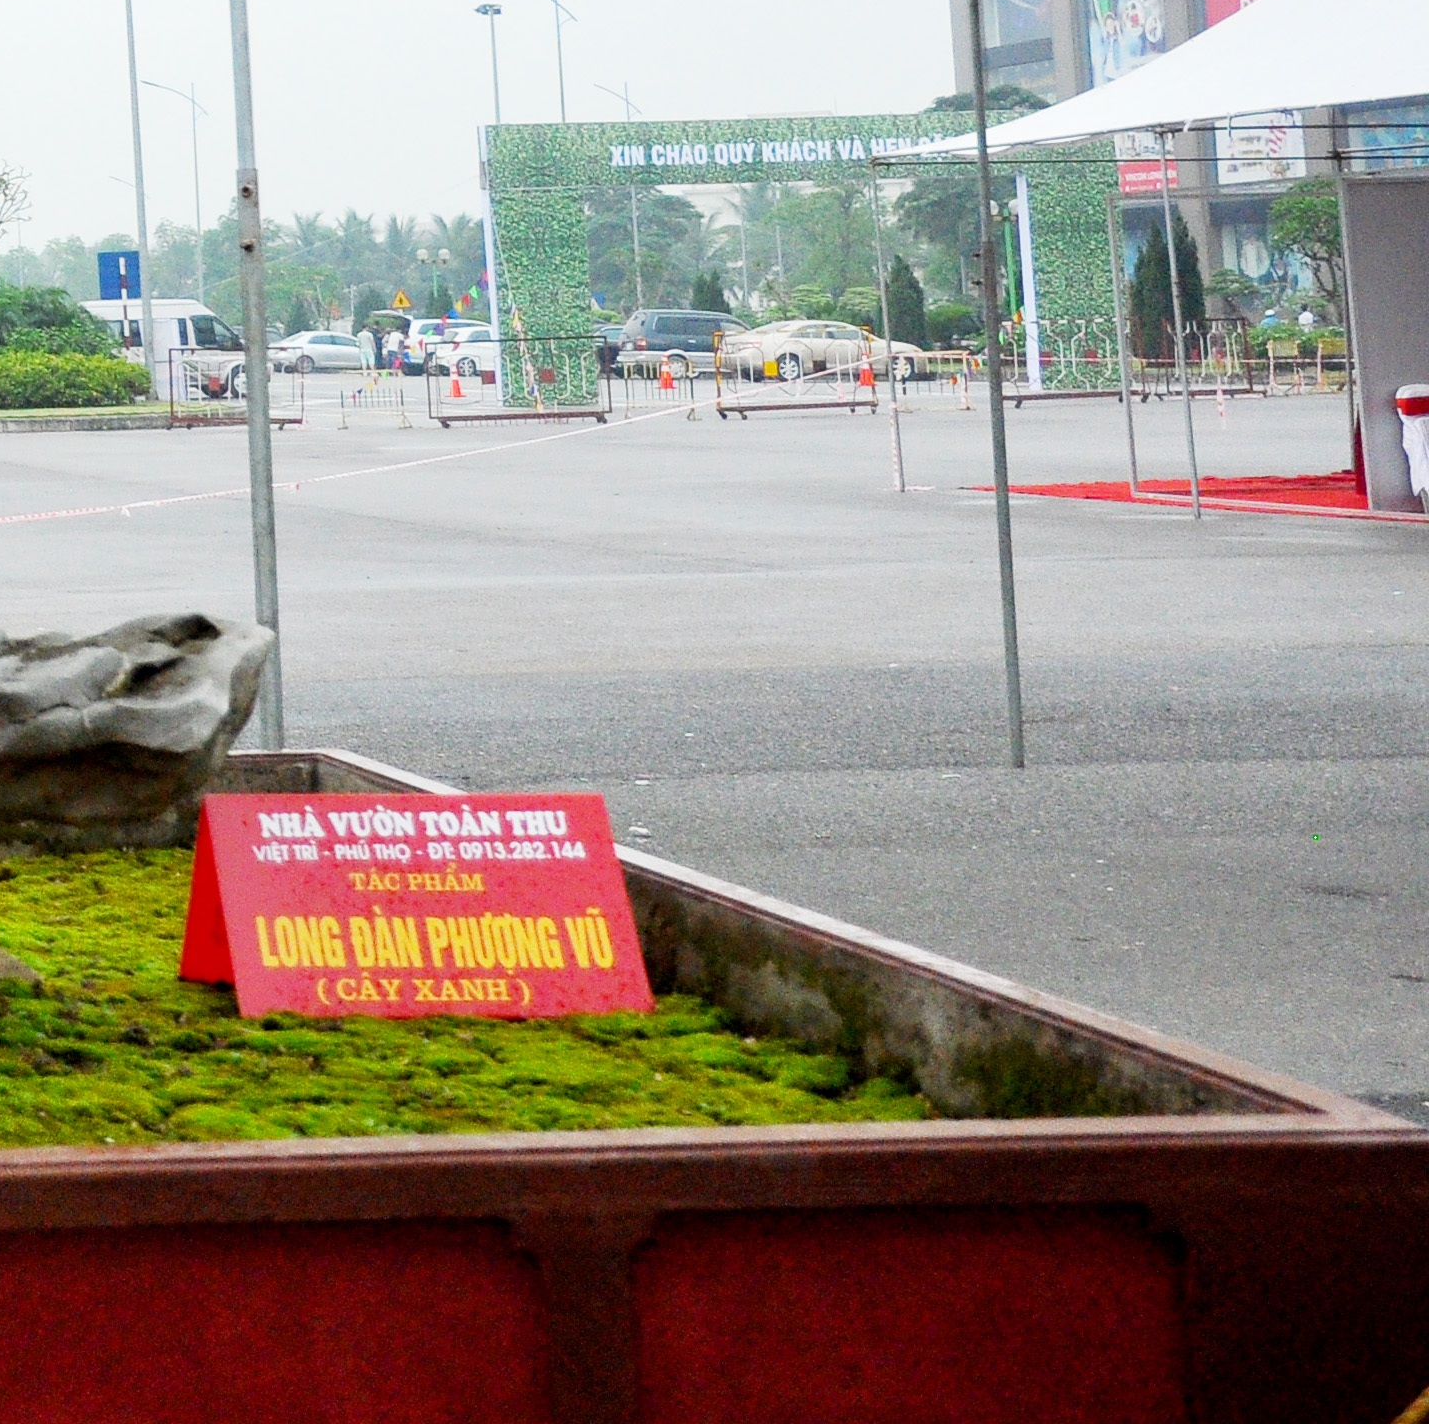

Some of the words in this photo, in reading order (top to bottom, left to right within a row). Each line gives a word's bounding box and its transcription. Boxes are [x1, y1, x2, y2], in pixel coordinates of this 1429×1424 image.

[610, 144, 644, 166] XIN
[651, 139, 708, 166] CHÀO
[714, 138, 755, 165] QUÝ
[762, 136, 831, 163] KHÁCH
[837, 135, 865, 160] VÀ
[258, 805, 326, 838] NHÀ
[327, 804, 415, 837] VƯỜN
[419, 804, 502, 837] TOÀN
[505, 810, 568, 836] THU
[252, 841, 289, 864] VIỆT
[293, 840, 319, 861] TRÌ
[334, 839, 371, 860] PHÚ
[373, 843, 411, 863] THỌ
[459, 841, 587, 860] 0913.282.144
[349, 867, 401, 891] TÁC
[407, 862, 485, 892] PHẨM
[256, 915, 347, 968] LONG
[349, 905, 424, 968] ĐÀN
[426, 911, 565, 975] PHƯỢNG
[565, 907, 615, 969] VŨ
